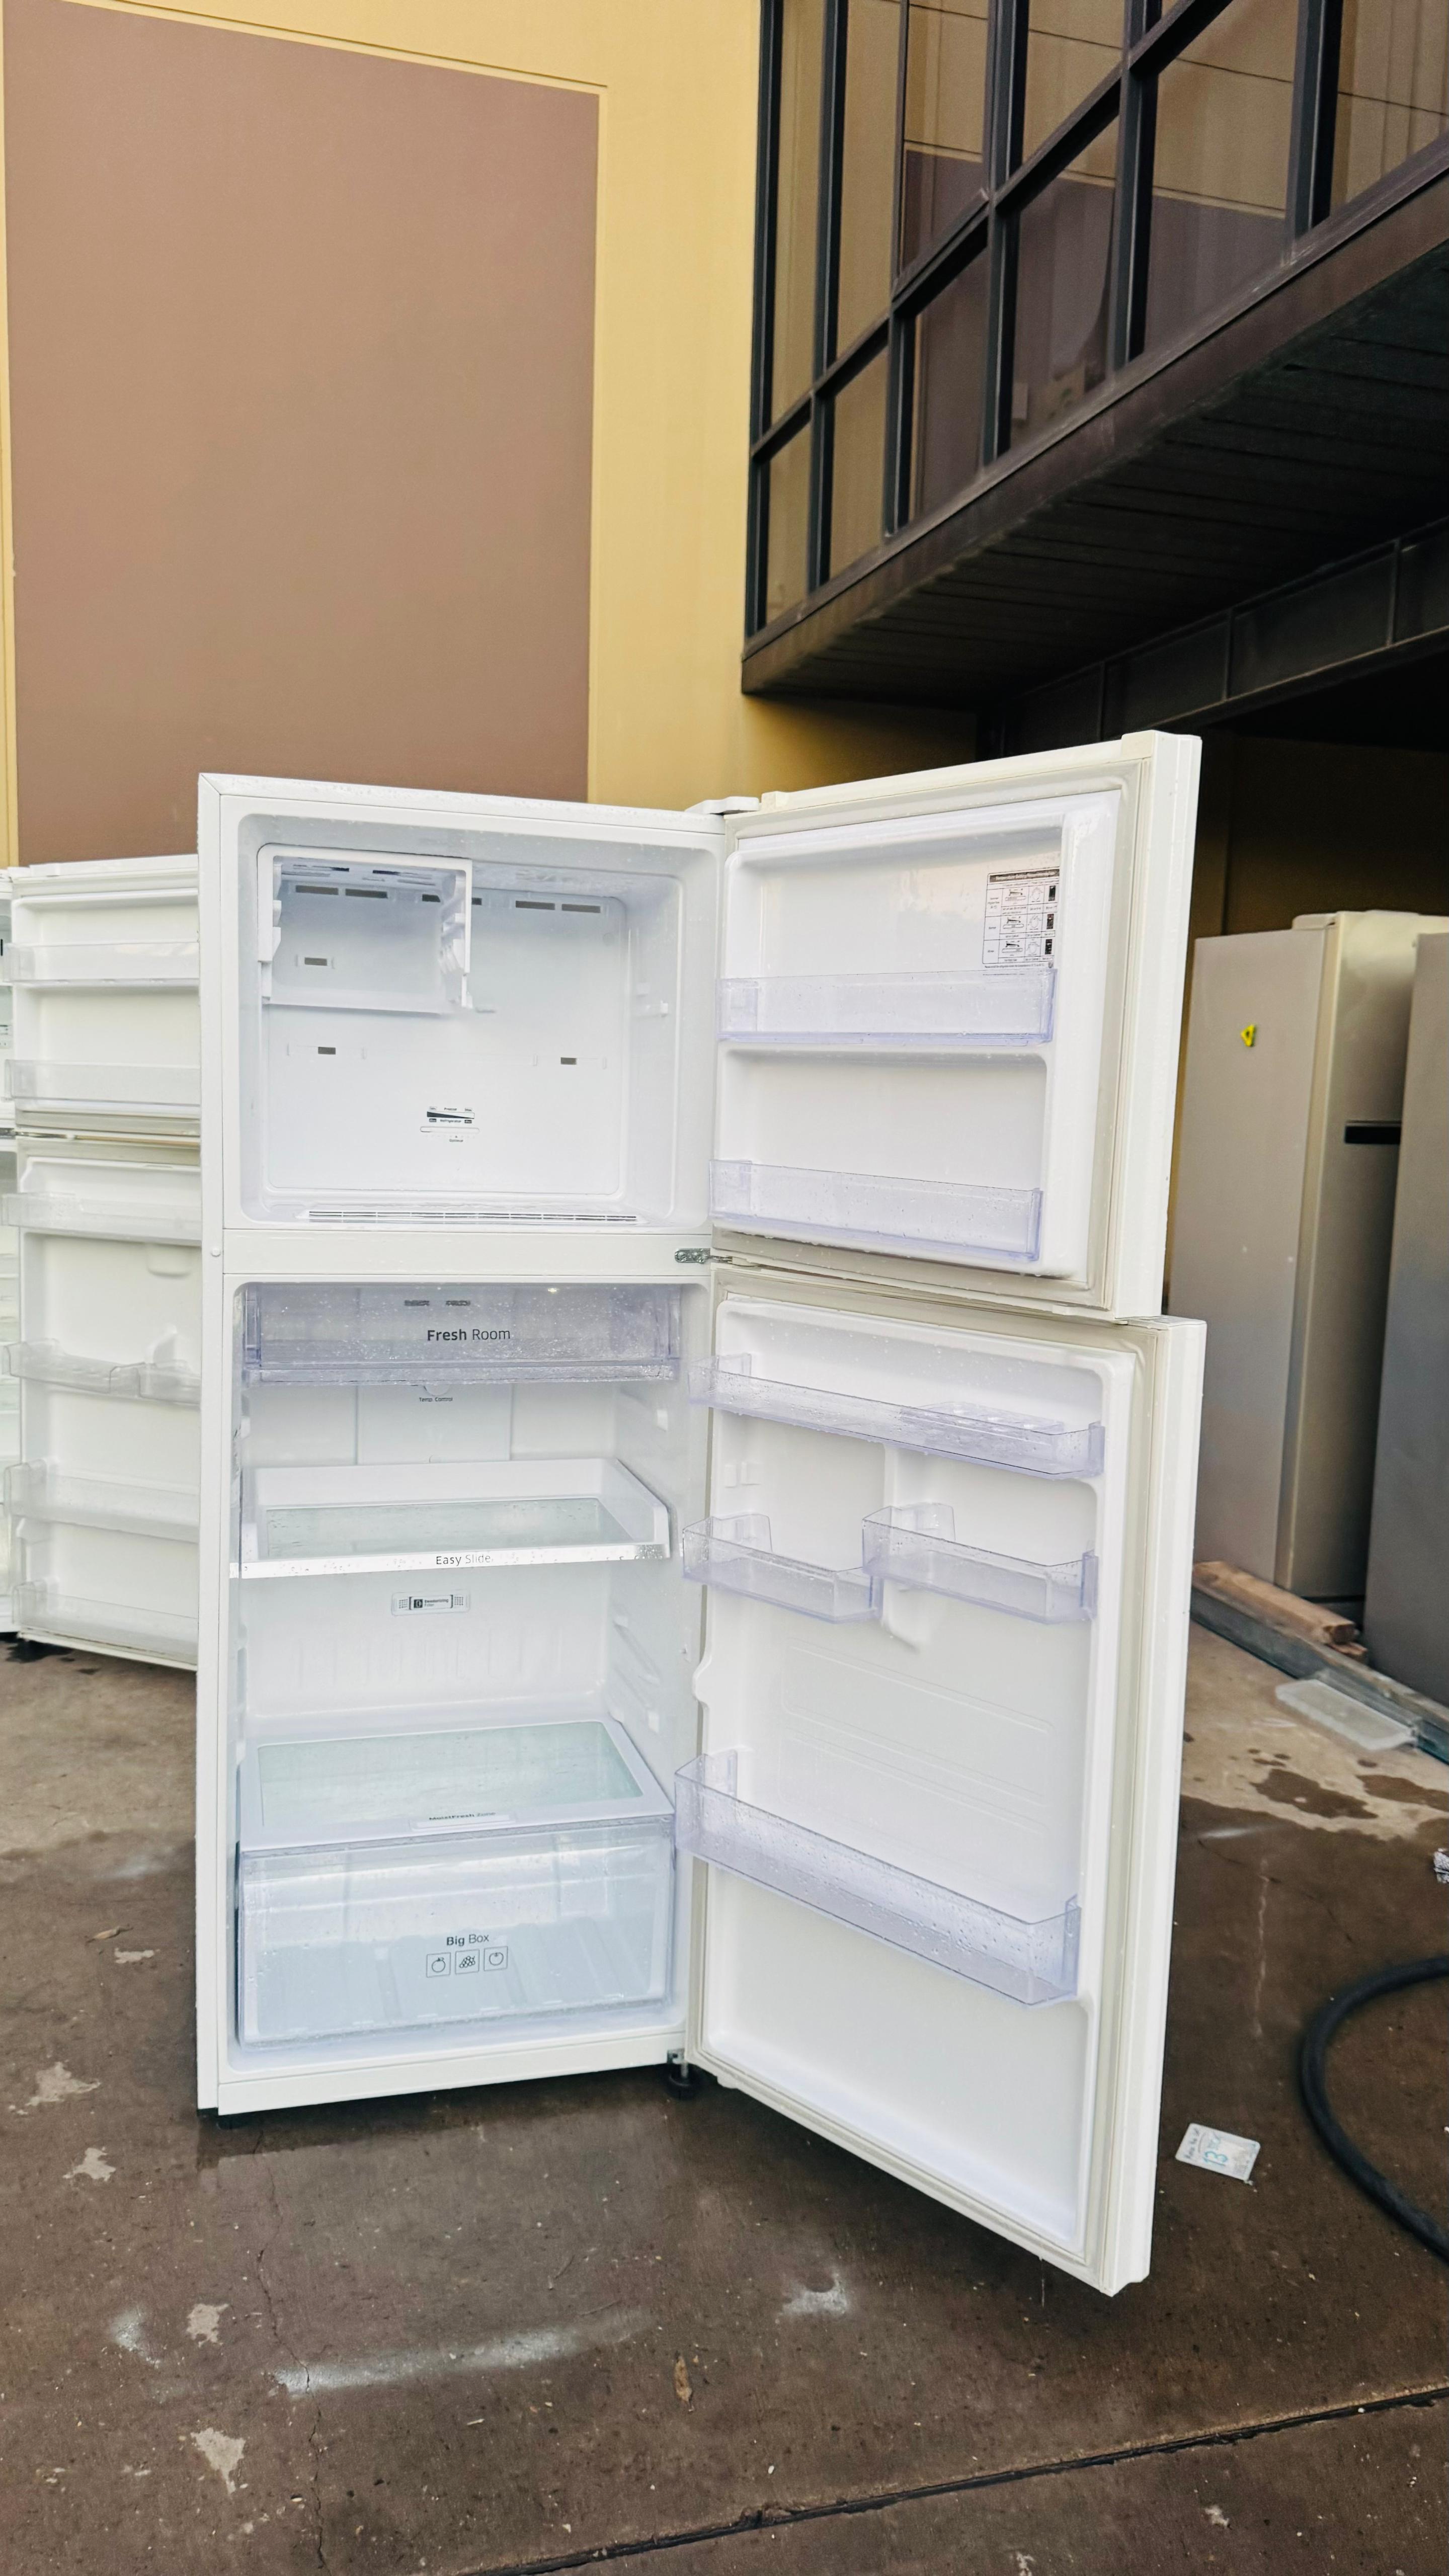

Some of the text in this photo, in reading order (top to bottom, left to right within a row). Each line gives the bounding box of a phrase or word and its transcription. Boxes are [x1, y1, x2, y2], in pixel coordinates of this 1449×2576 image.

[427, 1329, 510, 1341] Fresh Room
[436, 1554, 491, 1566] Easy Slide
[446, 1934, 490, 1947] Big Box
